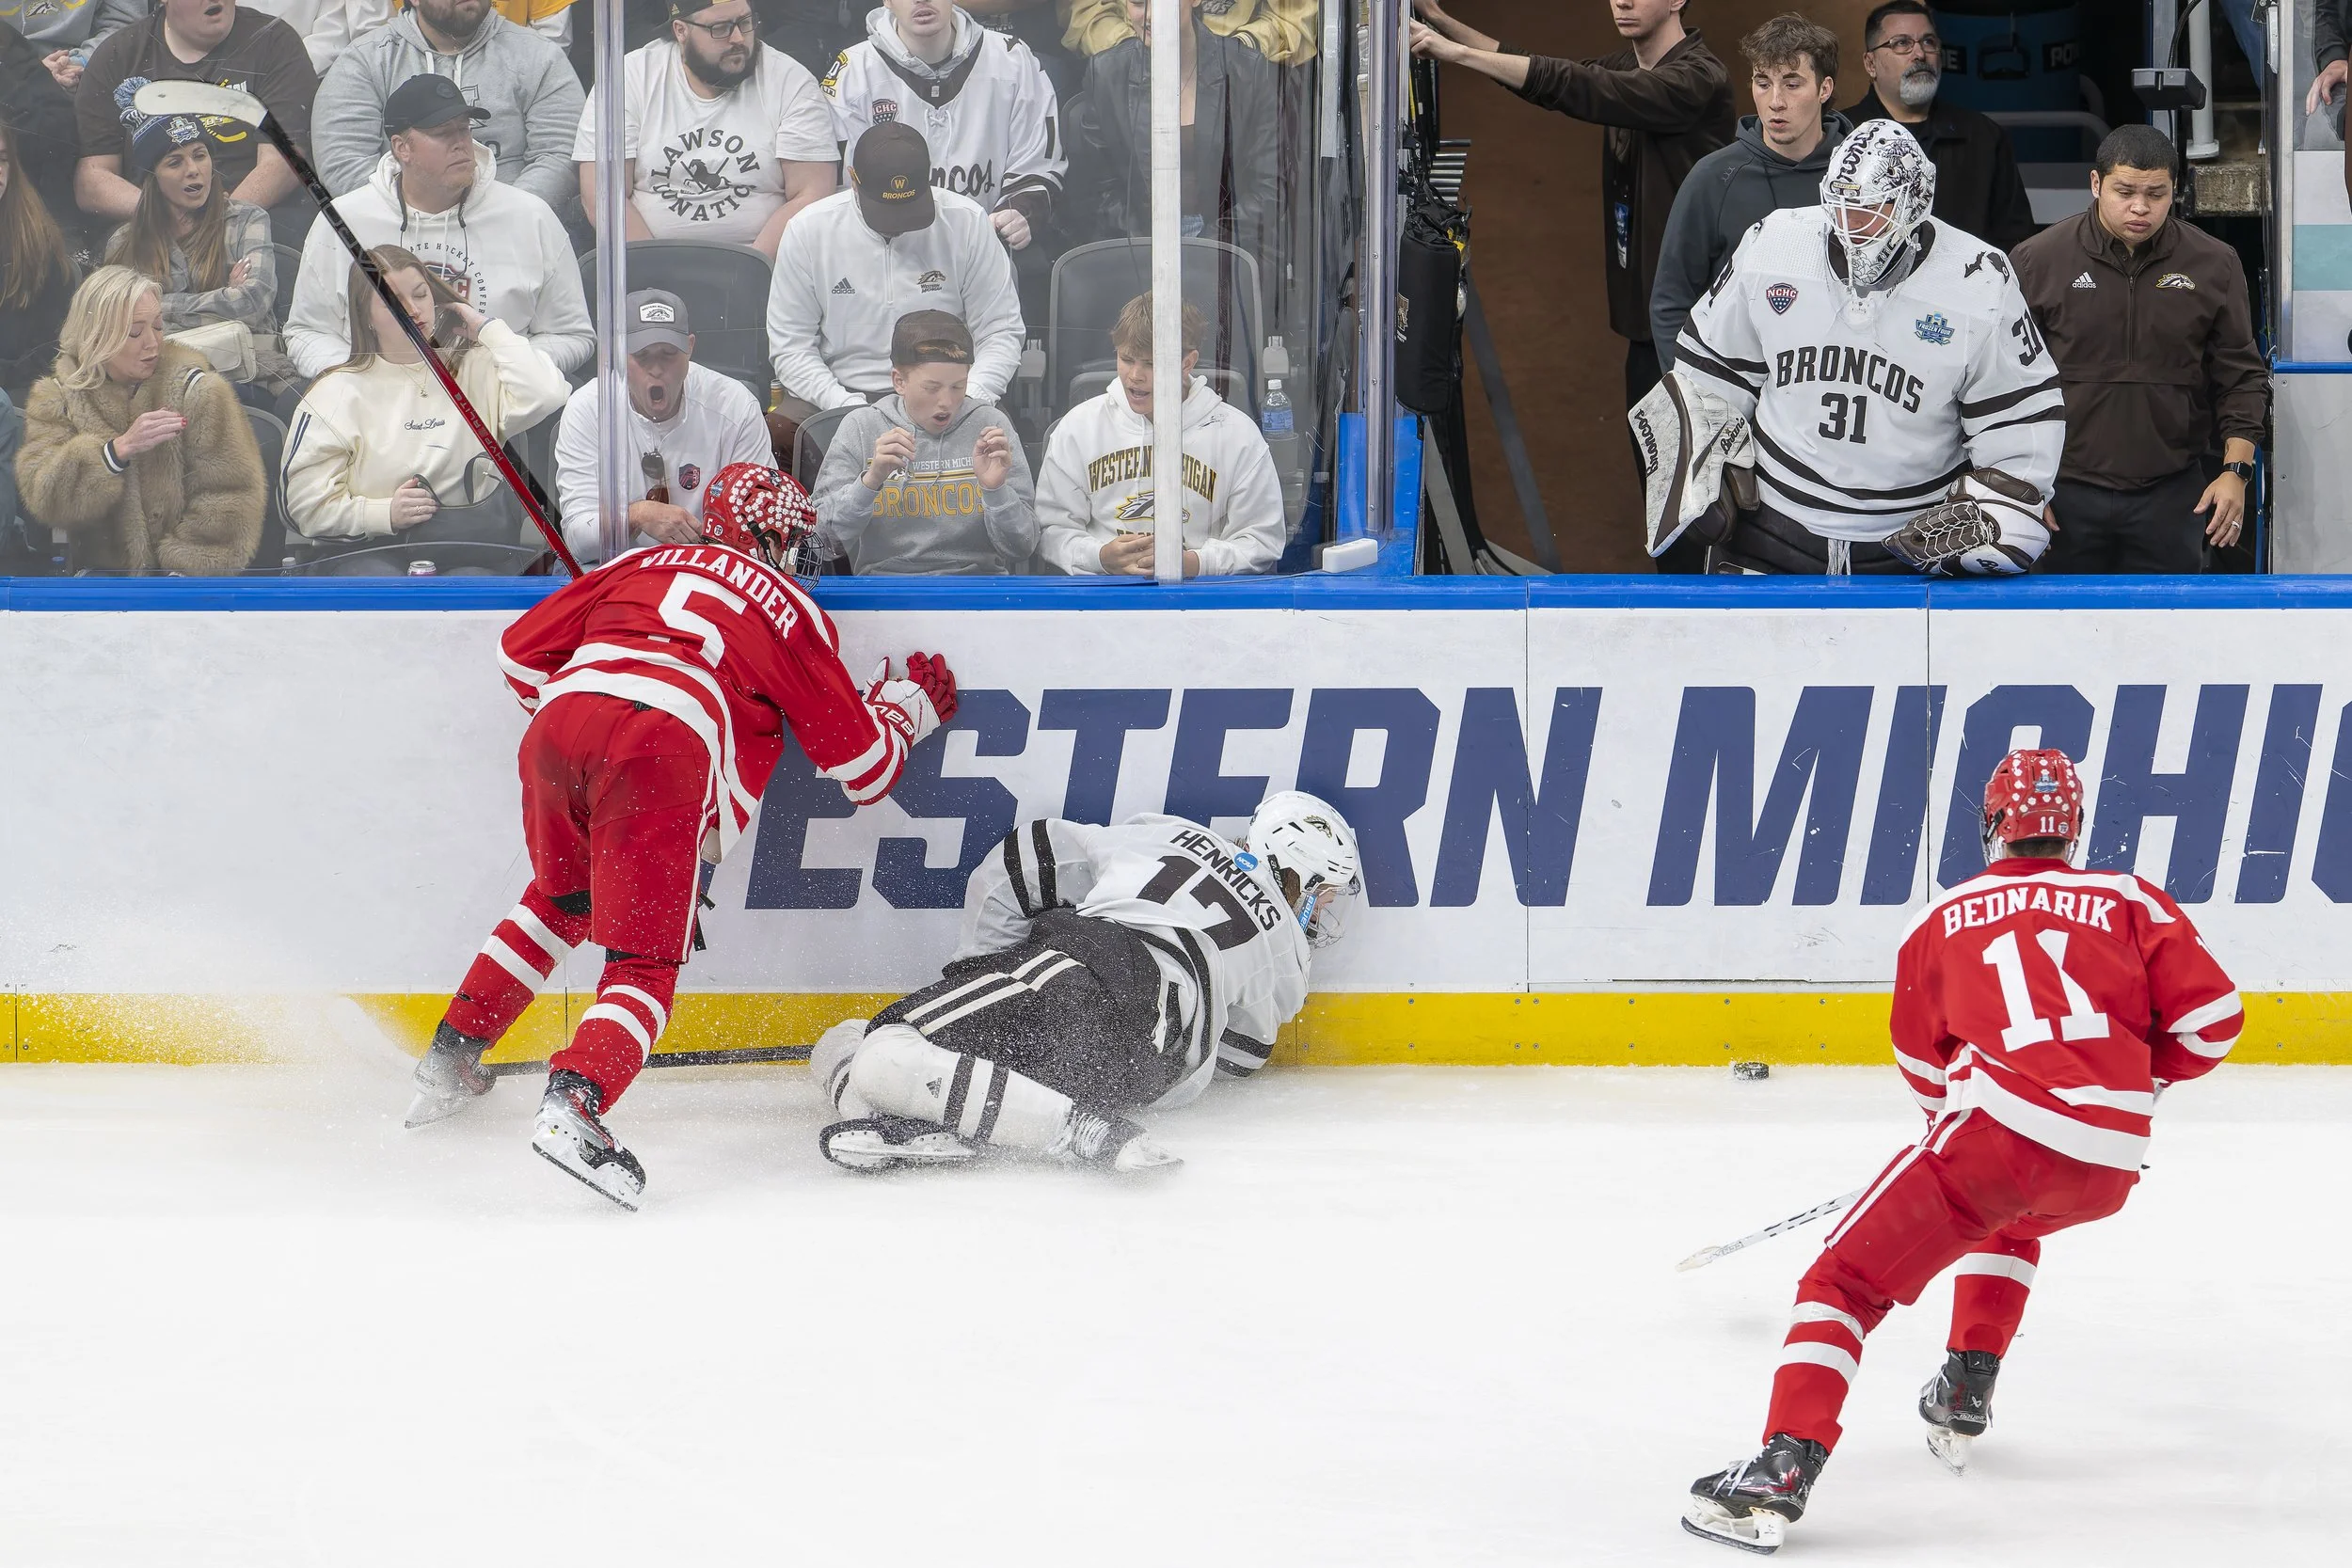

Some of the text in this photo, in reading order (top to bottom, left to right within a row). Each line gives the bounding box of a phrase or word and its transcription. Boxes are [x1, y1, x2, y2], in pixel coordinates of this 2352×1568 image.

[872, 103, 897, 115] CHC
[651, 128, 761, 179] LAWSON
[882, 189, 916, 200] BRONCOS
[894, 179, 905, 189] W
[928, 159, 995, 197] ncos
[475, 272, 486, 314] CONFER
[1767, 288, 1797, 298] NCHC
[1919, 323, 1938, 333] FROZEN
[2011, 309, 2043, 367] 31
[1776, 345, 1925, 414] BRONCOS
[405, 418, 445, 431] Saint Louis
[1819, 391, 1868, 445] 31
[912, 458, 951, 471] WESTERN
[1088, 445, 1152, 493] WESTERN
[872, 482, 985, 518] BRONCOS
[706, 518, 714, 534] 5
[639, 548, 799, 640] WILLANDER
[659, 572, 748, 669] 5
[743, 687, 1603, 910] ESTERN
[2040, 816, 2055, 833] 11
[1169, 830, 1281, 931] HENRICKS
[1236, 855, 1254, 869] NCAA
[1136, 855, 1261, 951] 17
[1943, 887, 2117, 938] BEDNARIK
[1981, 929, 2110, 1053] 11
